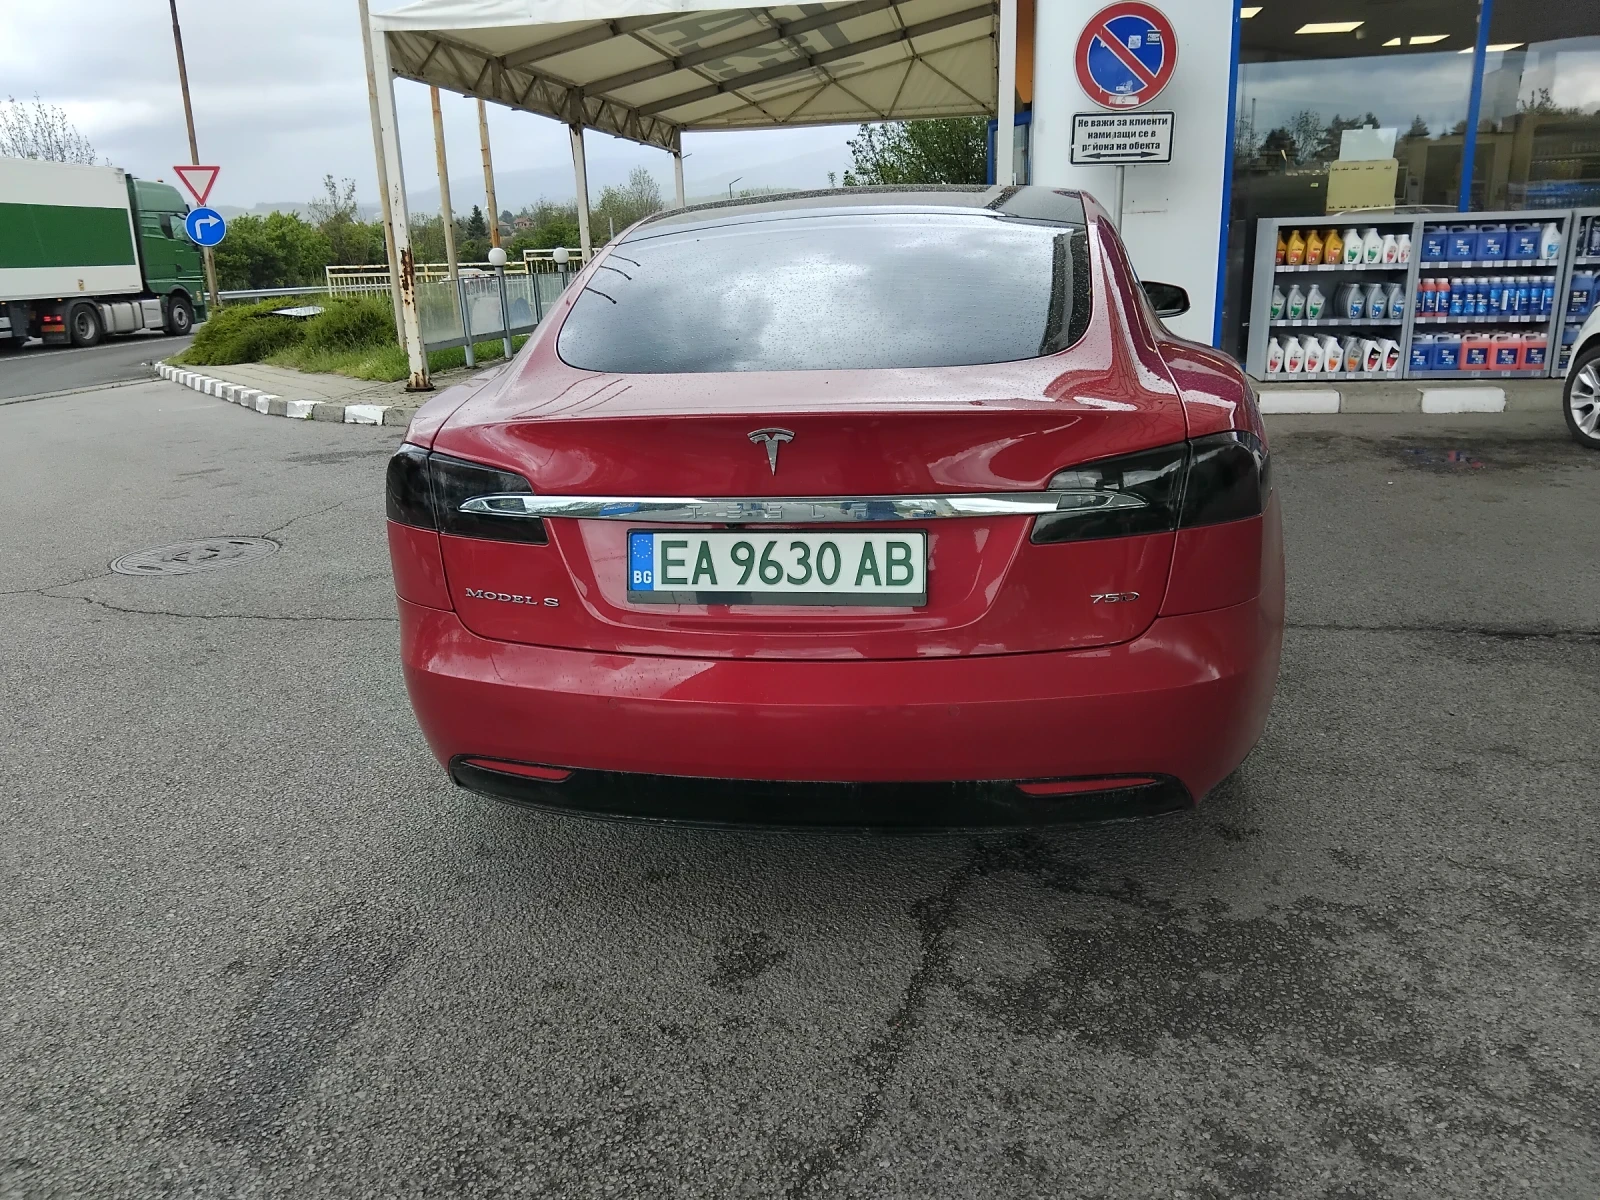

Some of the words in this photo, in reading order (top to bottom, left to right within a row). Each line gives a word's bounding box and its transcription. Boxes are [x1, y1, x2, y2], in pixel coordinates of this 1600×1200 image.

[1077, 118, 1089, 128] Не
[1090, 118, 1115, 127] важи
[1116, 118, 1128, 127] за
[1129, 117, 1168, 126] клиенти
[1138, 130, 1149, 138] се
[1116, 142, 1127, 151] на
[1128, 141, 1161, 150] обекта
[686, 503, 869, 520] TESLA
[660, 540, 718, 585] EA
[730, 540, 842, 586] 9630
[854, 541, 914, 586] AB
[632, 570, 653, 584] BG
[465, 587, 538, 605] MODEL
[543, 597, 560, 607] S
[1089, 591, 1140, 604] 75D
